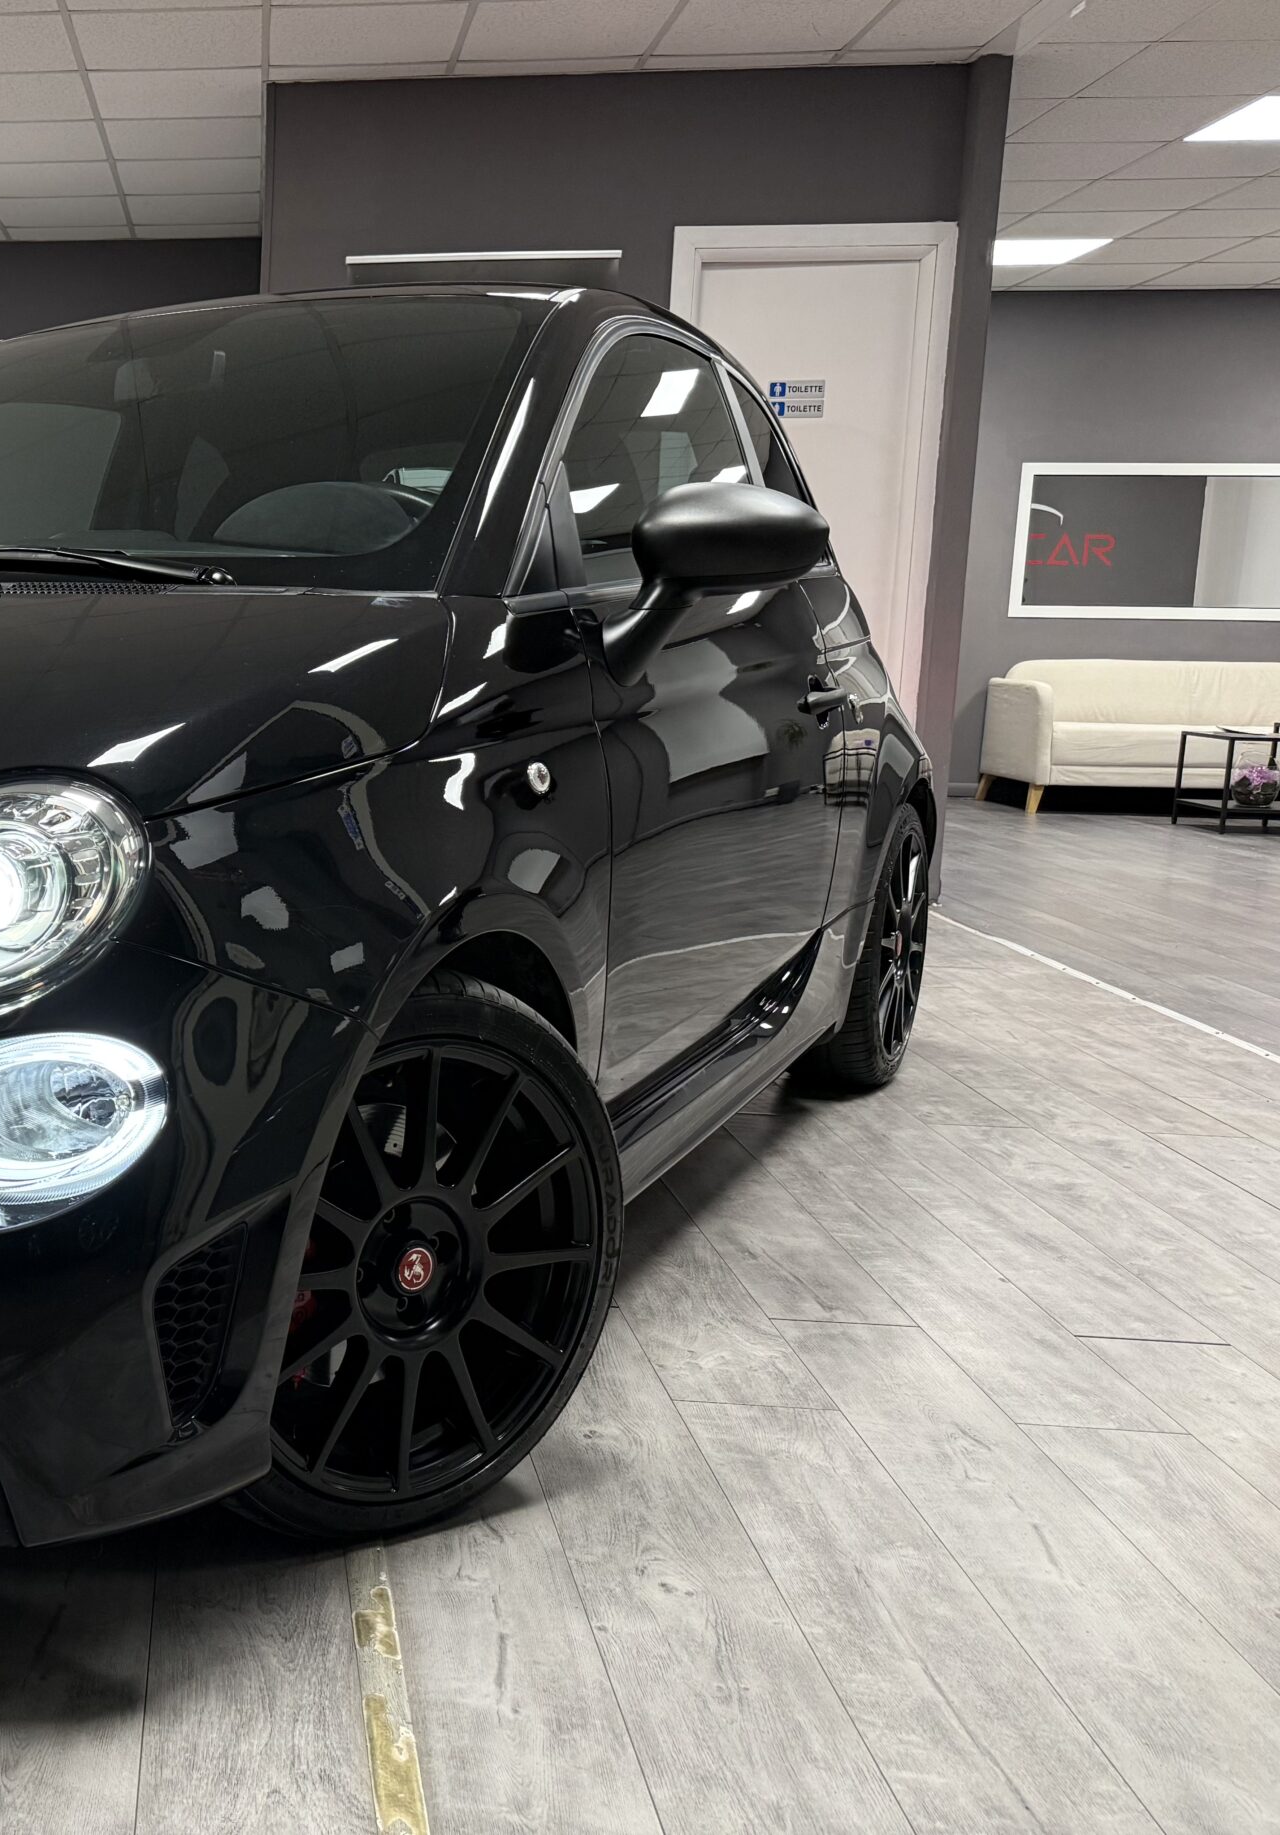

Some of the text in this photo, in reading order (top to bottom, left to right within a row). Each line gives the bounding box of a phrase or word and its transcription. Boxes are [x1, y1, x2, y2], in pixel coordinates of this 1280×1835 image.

[787, 385, 823, 393] TOILETTE
[786, 404, 822, 413] TOILETTE
[588, 1112, 620, 1283] OURADOR
